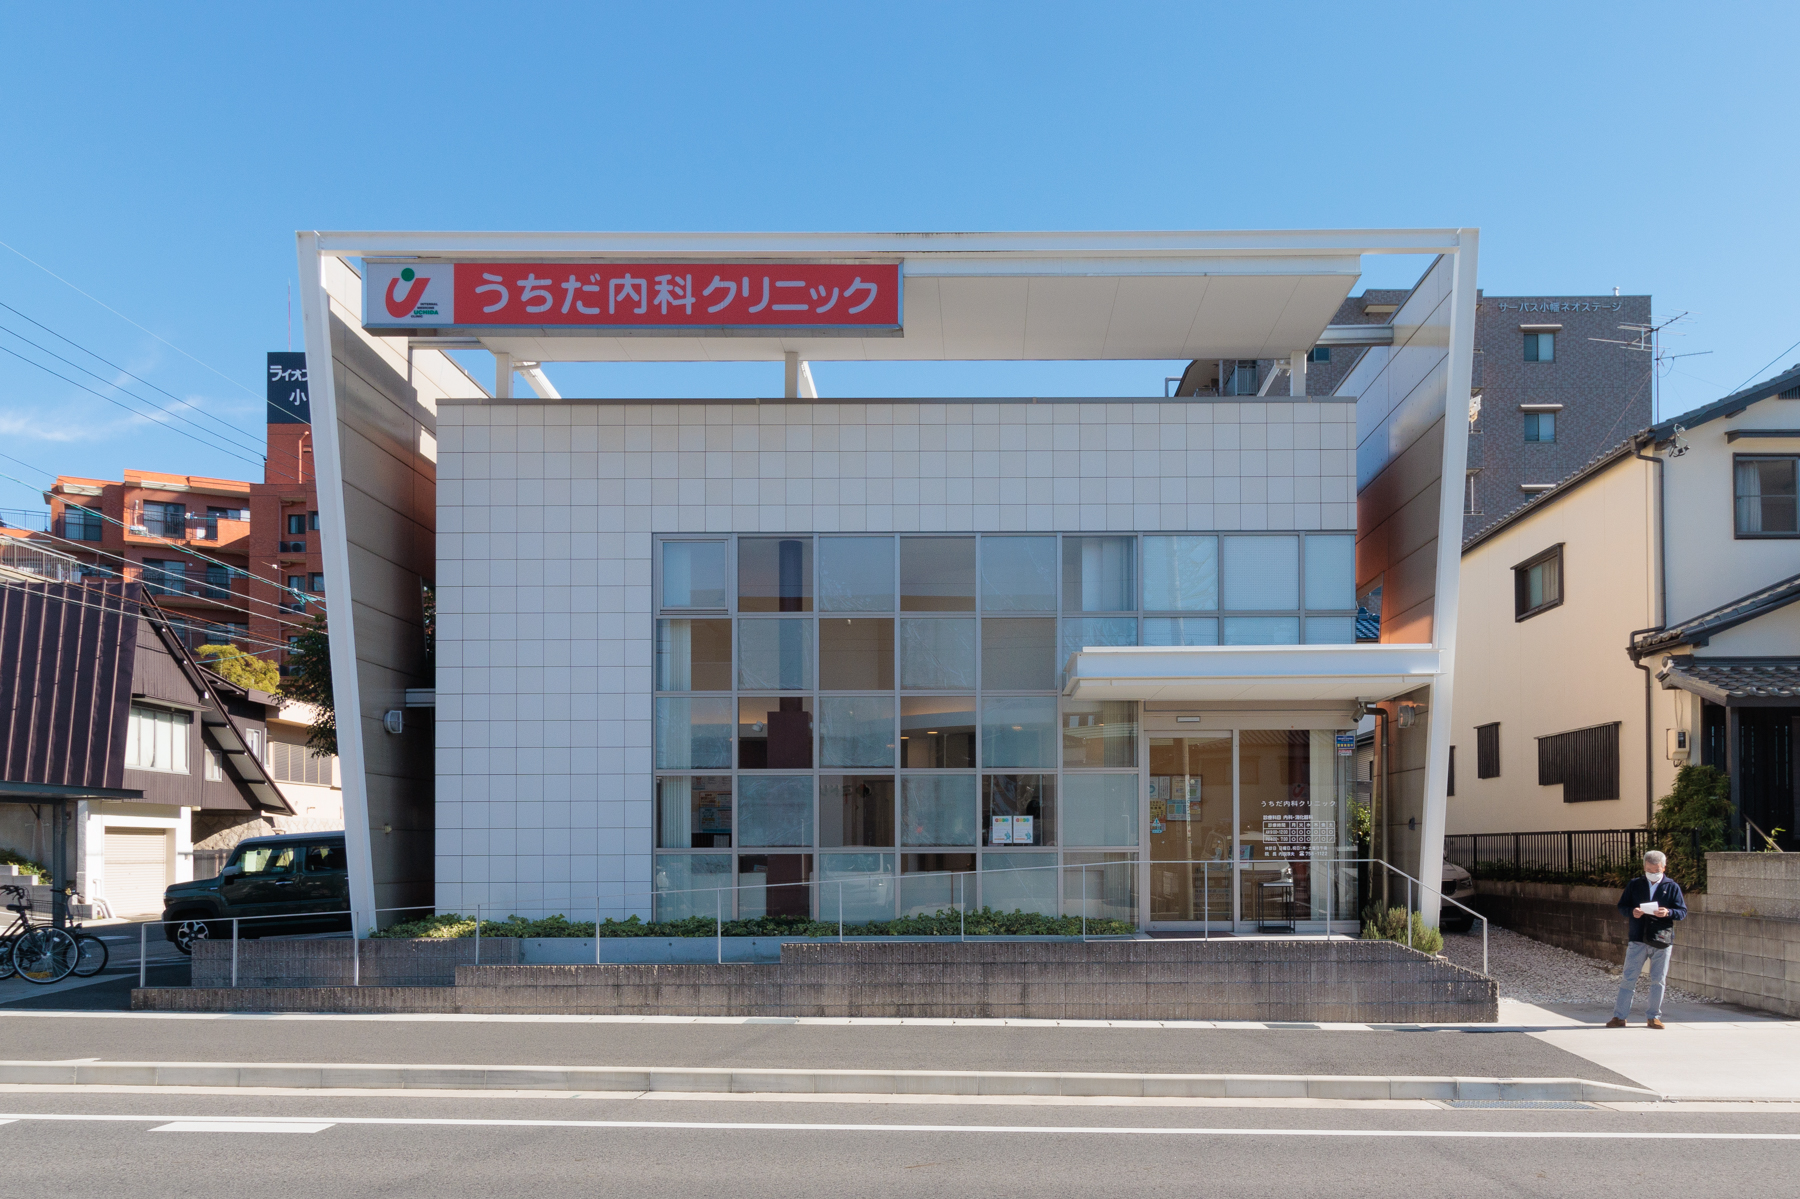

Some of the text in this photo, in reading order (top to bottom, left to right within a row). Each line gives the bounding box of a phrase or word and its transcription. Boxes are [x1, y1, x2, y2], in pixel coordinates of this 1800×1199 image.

[474, 272, 879, 315] うちだ内科クリニック
[289, 388, 307, 406] 小
